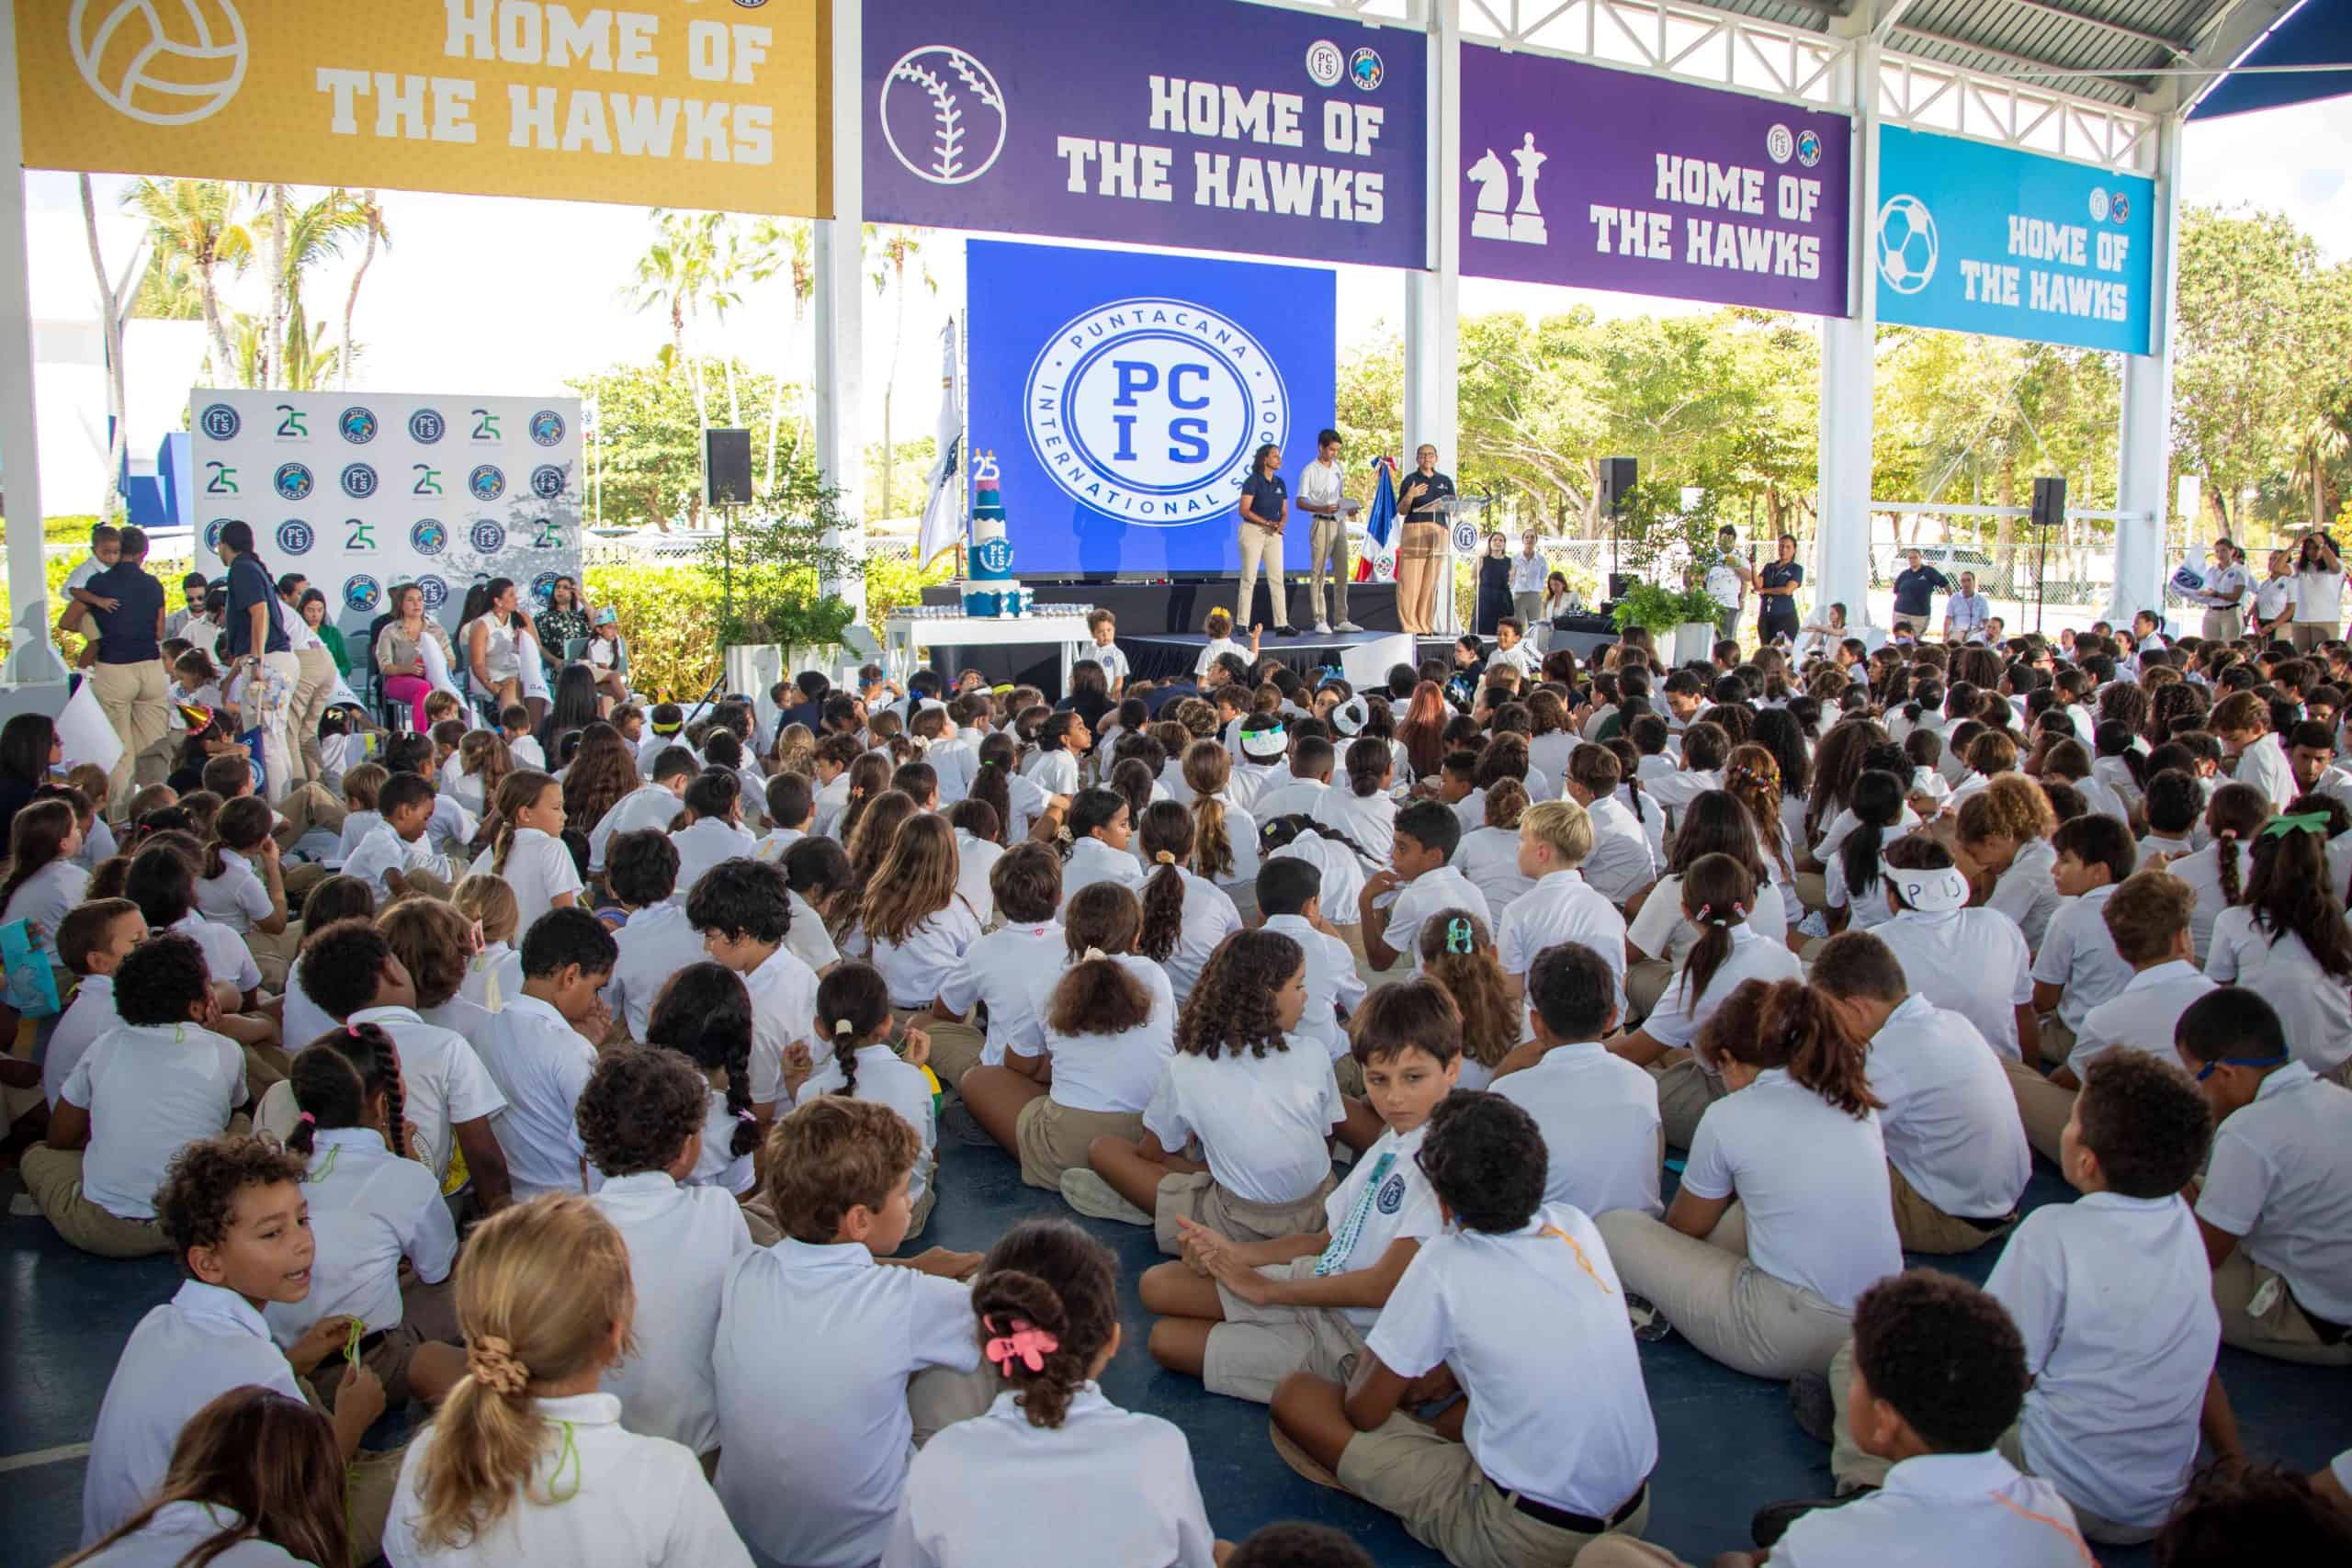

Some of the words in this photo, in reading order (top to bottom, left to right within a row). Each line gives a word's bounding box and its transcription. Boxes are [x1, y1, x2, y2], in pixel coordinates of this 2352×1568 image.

[445, 0, 658, 75] HOME
[688, 20, 773, 85] OF
[1317, 51, 1332, 64] PC
[1317, 63, 1332, 74] IS
[317, 68, 477, 143] THE
[508, 84, 773, 165] HAWKS
[1148, 74, 1303, 148] HOME
[1323, 100, 1384, 156] OF
[1057, 136, 1172, 202] THE
[1194, 152, 1384, 224] HAWKS
[1655, 153, 1765, 215] HOME
[1778, 175, 1821, 222] OF
[1589, 204, 1672, 261] THE
[1686, 218, 1820, 280] HAWKS
[2008, 215, 2087, 266] HOME
[2097, 231, 2129, 273] OF
[1960, 259, 2020, 307] THE
[2029, 270, 2128, 321] HAWKS
[1070, 310, 1248, 359] PUNTACANA
[1112, 359, 1210, 411] PC
[212, 413, 229, 423] PC
[212, 423, 230, 432] IS
[276, 404, 309, 437] 25
[419, 418, 435, 427] PC
[419, 426, 435, 436] IS
[470, 409, 501, 440] 25
[1039, 384, 1219, 515] INTERNATIONAL
[1230, 394, 1277, 491] SCOOL
[1112, 414, 1210, 464] IS
[206, 460, 240, 493] 25
[352, 471, 368, 480] PC
[413, 463, 443, 495] 25
[972, 455, 1001, 481] 25
[352, 480, 368, 491] IS
[287, 528, 303, 537] PC
[288, 537, 304, 547] IS
[345, 518, 376, 549] 25
[533, 517, 562, 548] 25
[989, 544, 1005, 555] PC
[989, 555, 1006, 567] IS
[423, 583, 438, 592] PC
